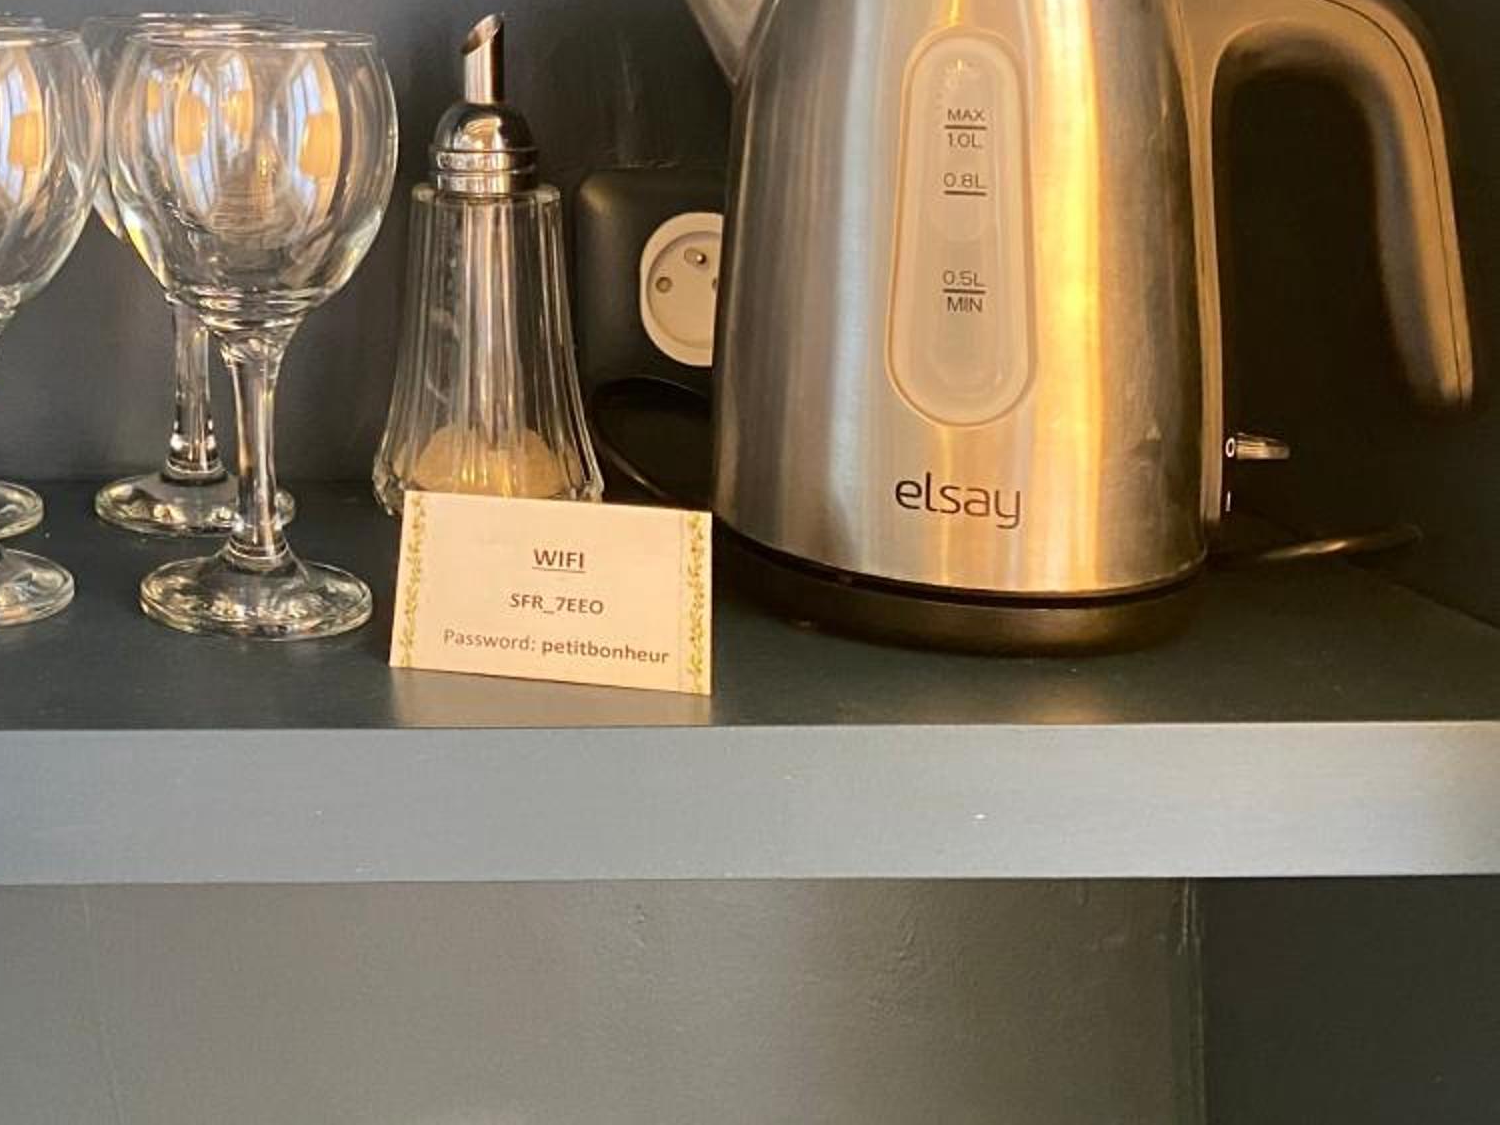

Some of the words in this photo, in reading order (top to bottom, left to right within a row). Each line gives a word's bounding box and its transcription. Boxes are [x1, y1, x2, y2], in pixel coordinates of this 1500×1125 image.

[947, 108, 985, 122] MAX
[943, 172, 987, 190] 0.8L
[942, 270, 985, 287] 0.5L
[947, 297, 983, 312] MIN
[895, 471, 1021, 529] elsay
[533, 548, 585, 571] WIFI
[443, 629, 536, 652] Password:
[541, 640, 670, 664] petitbonheur
